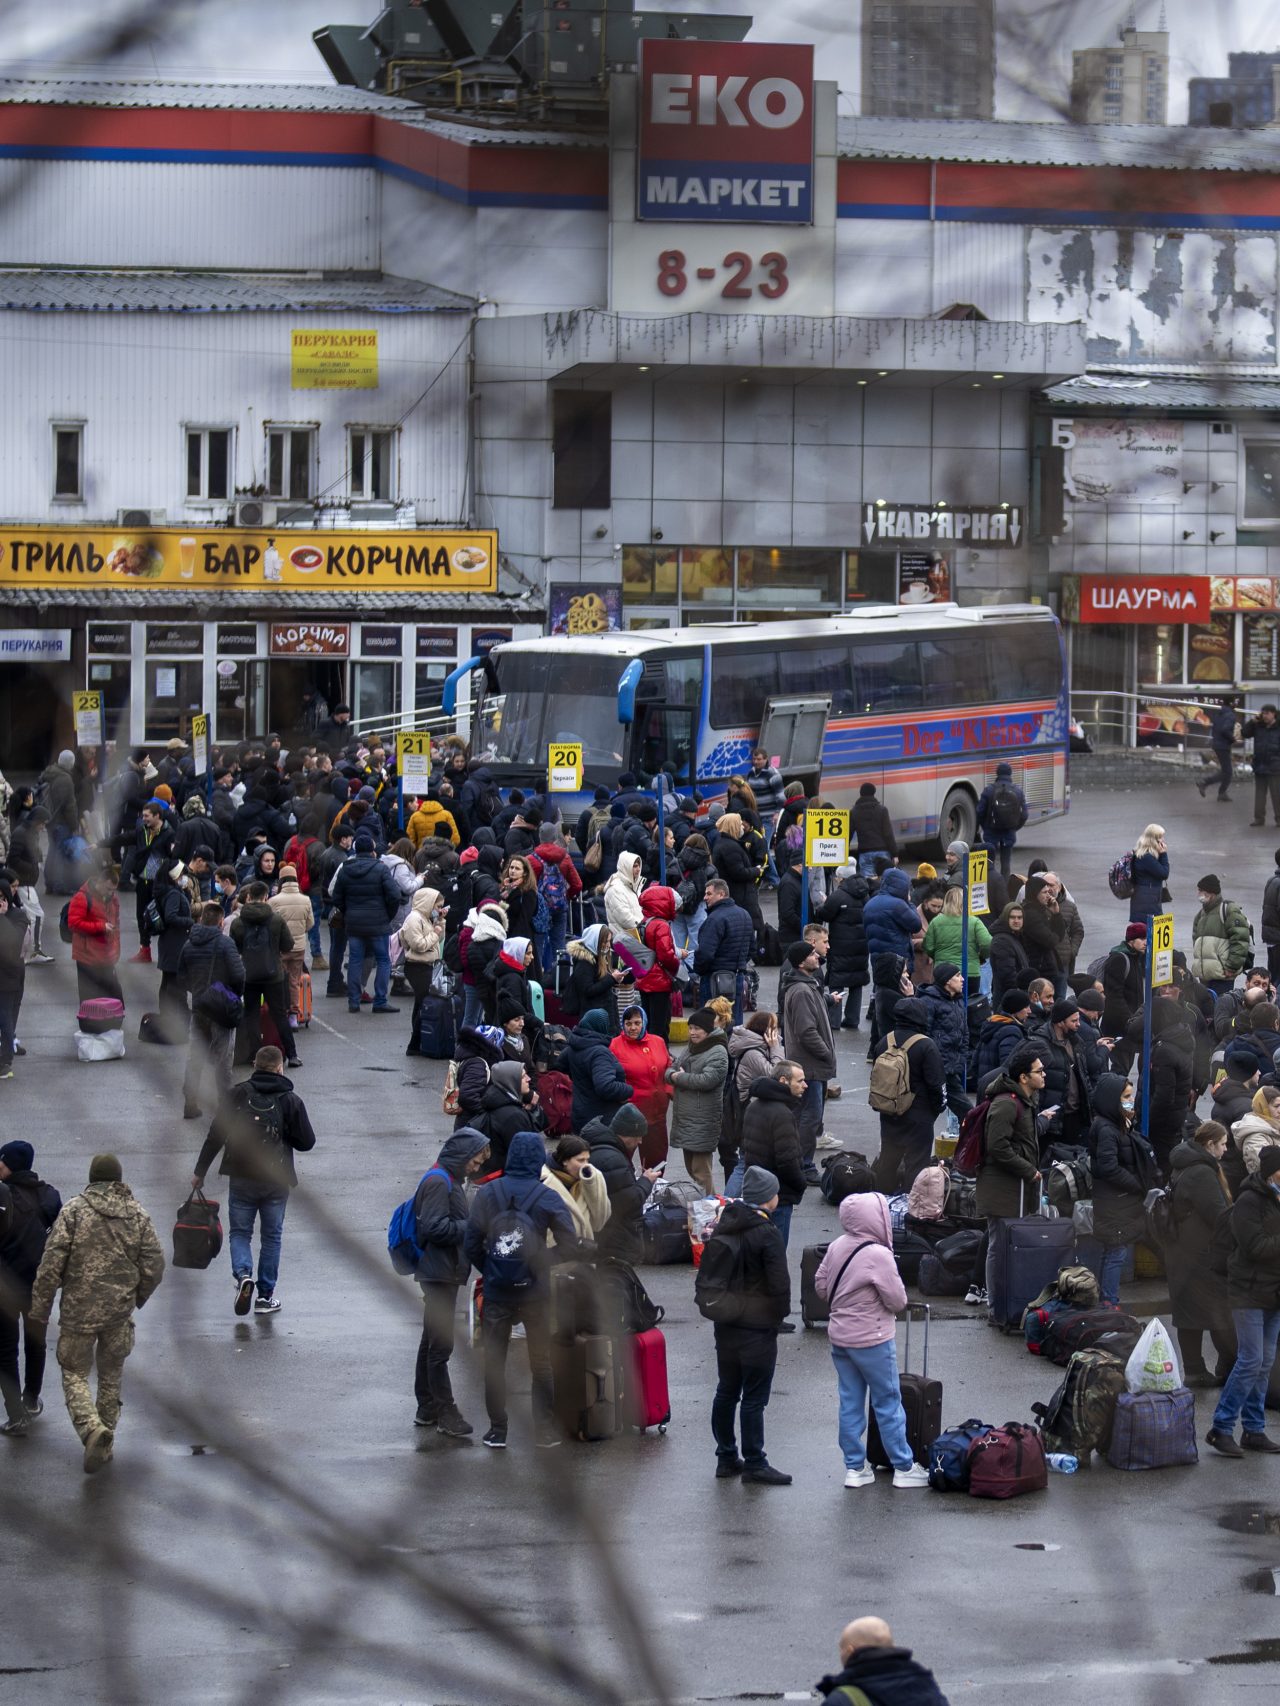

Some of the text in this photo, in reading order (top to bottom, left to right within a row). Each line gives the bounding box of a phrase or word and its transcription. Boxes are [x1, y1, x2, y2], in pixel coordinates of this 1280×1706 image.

[651, 74, 804, 129] ЕКО
[647, 176, 806, 207] МАРКЕТ
[657, 250, 789, 298] 8-23
[294, 335, 376, 346] ПЕРУКАРНЯ
[10, 541, 451, 577] ГРИЛЬ БАР КОРЧМА
[1092, 587, 1197, 611] ШАУРМА
[2, 640, 63, 651] ПЕРУКАРНЯ
[275, 626, 345, 647] КОРЧМА
[79, 697, 99, 710] 23
[196, 721, 206, 736] 22
[403, 738, 423, 753] 21
[902, 724, 944, 756] Der
[555, 751, 577, 766] 20
[815, 818, 842, 836] 18
[973, 861, 984, 881] 17
[1157, 925, 1170, 949] 16
